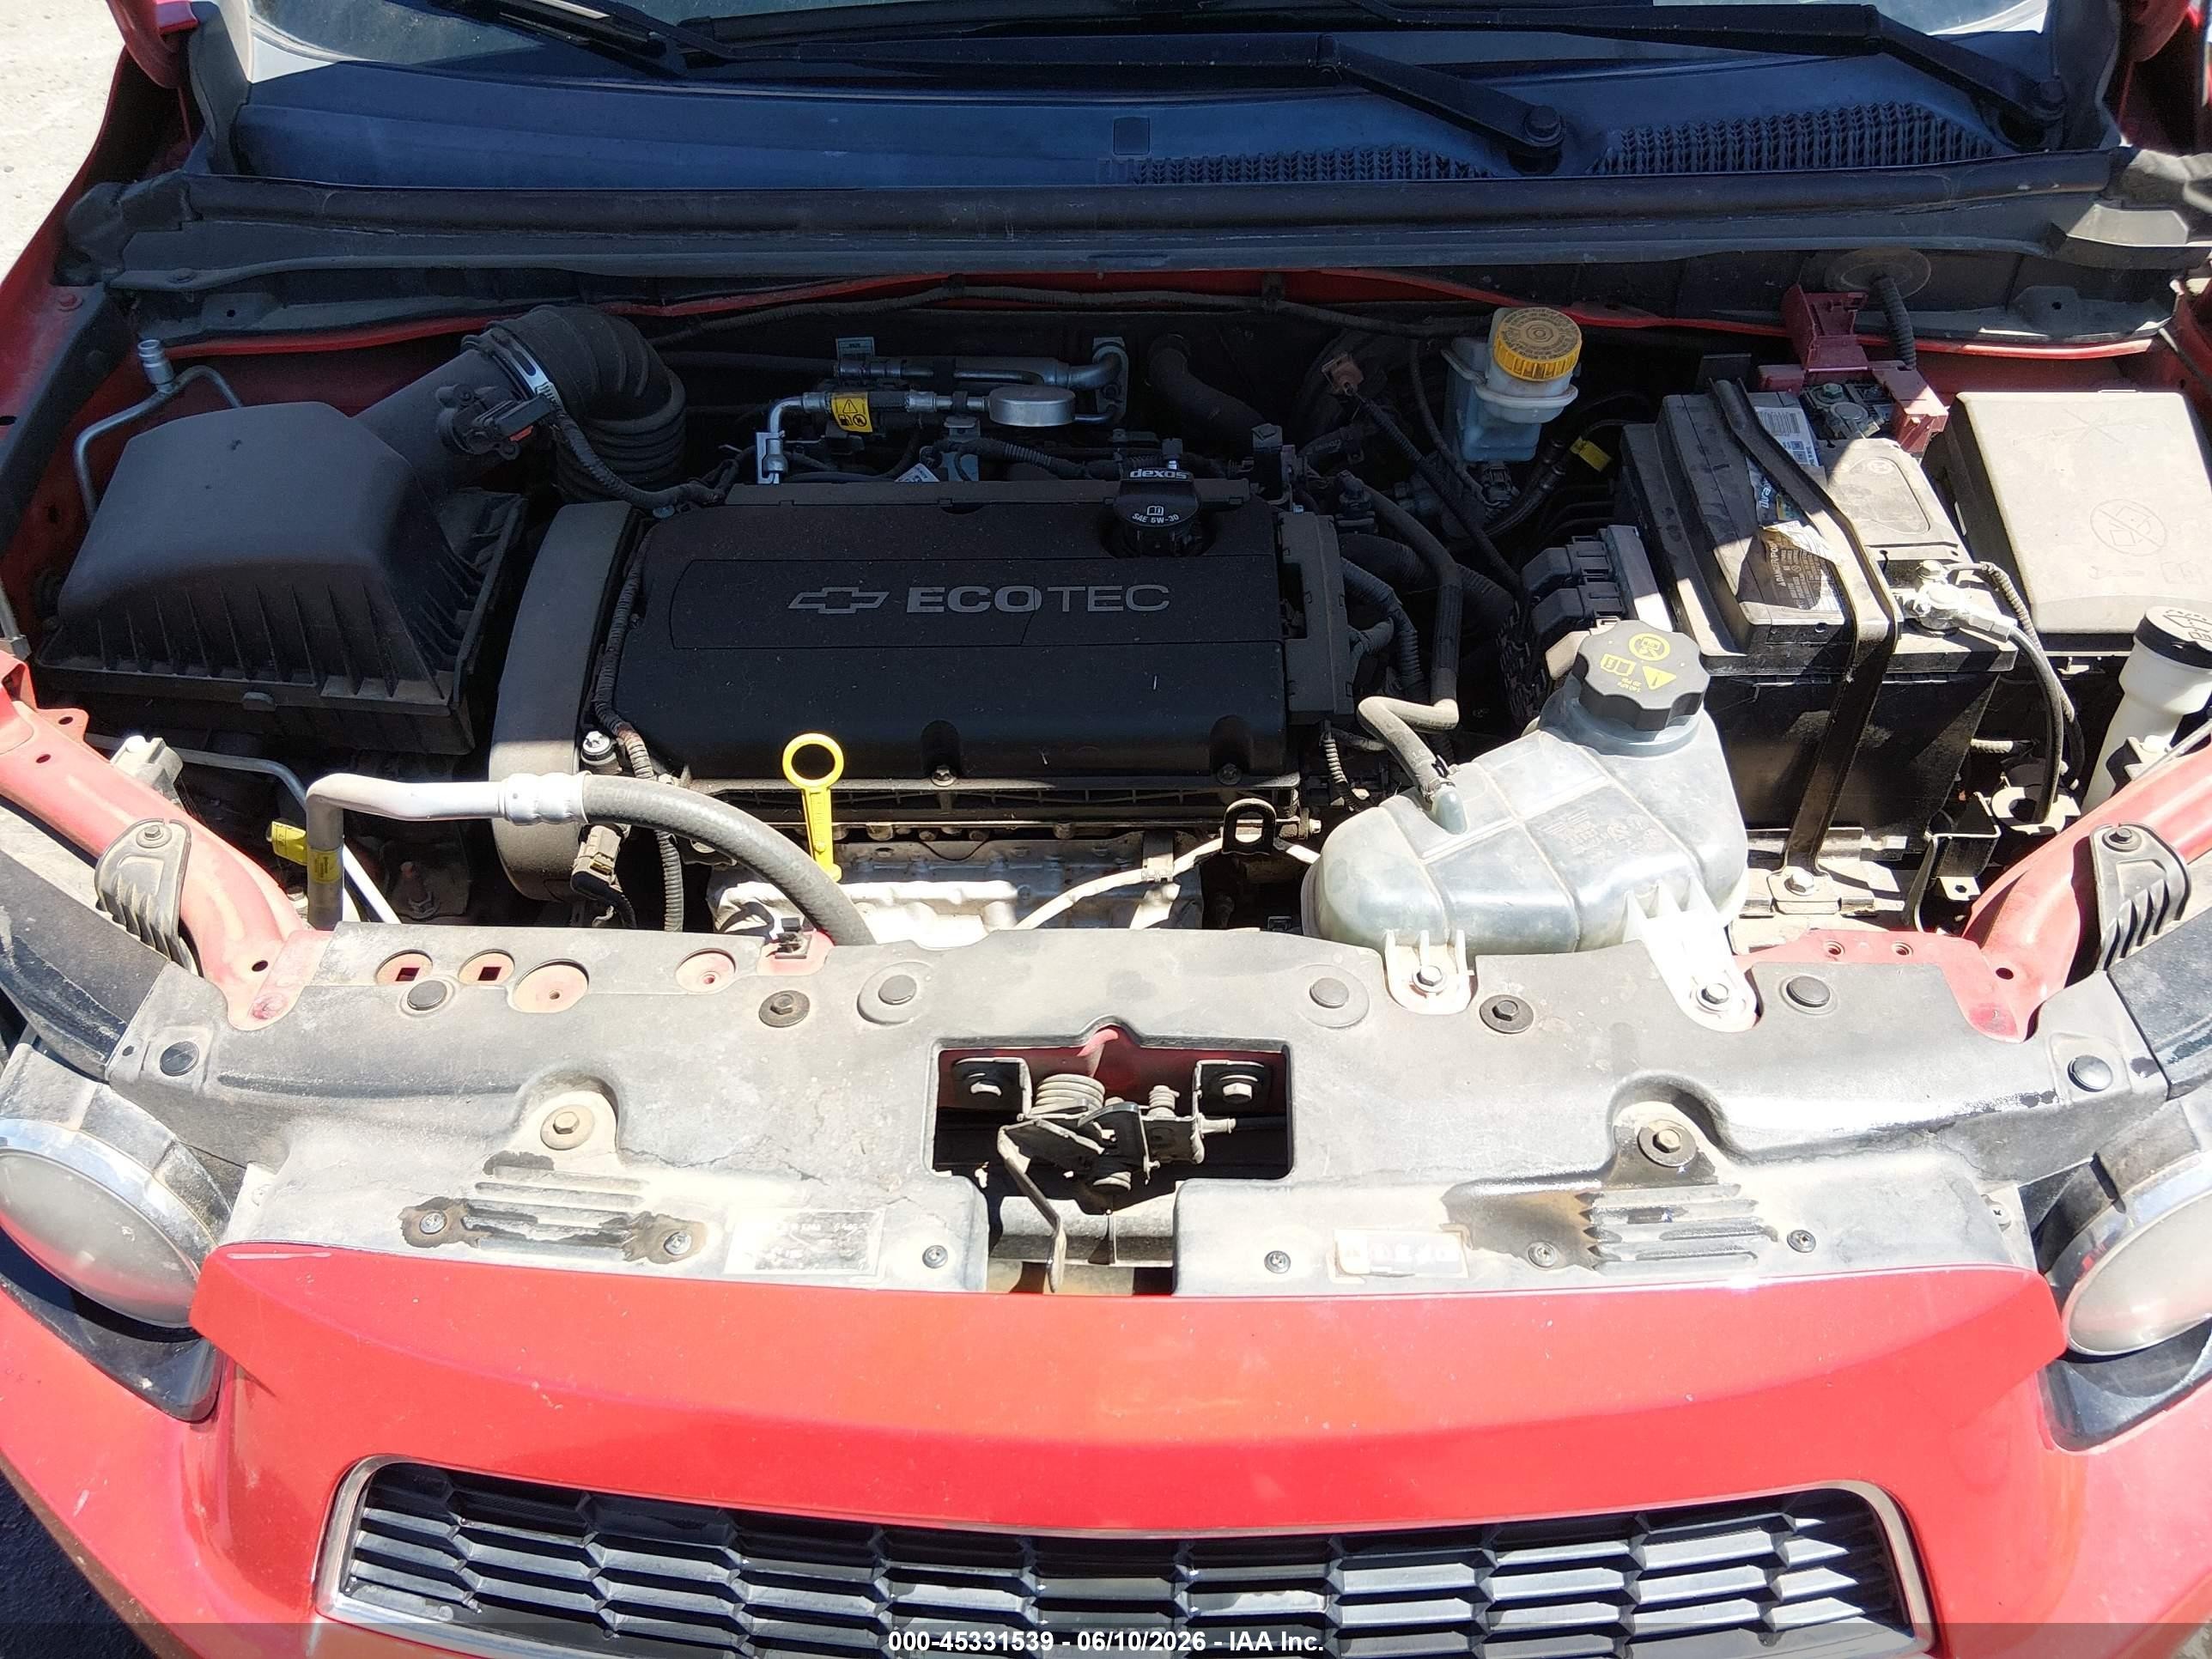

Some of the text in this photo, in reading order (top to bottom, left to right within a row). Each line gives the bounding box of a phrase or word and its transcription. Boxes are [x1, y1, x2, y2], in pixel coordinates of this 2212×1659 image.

[1129, 468, 1190, 479] dexos
[1132, 513, 1180, 524] SAE 5W-30
[906, 585, 1170, 613] ECOTEC
